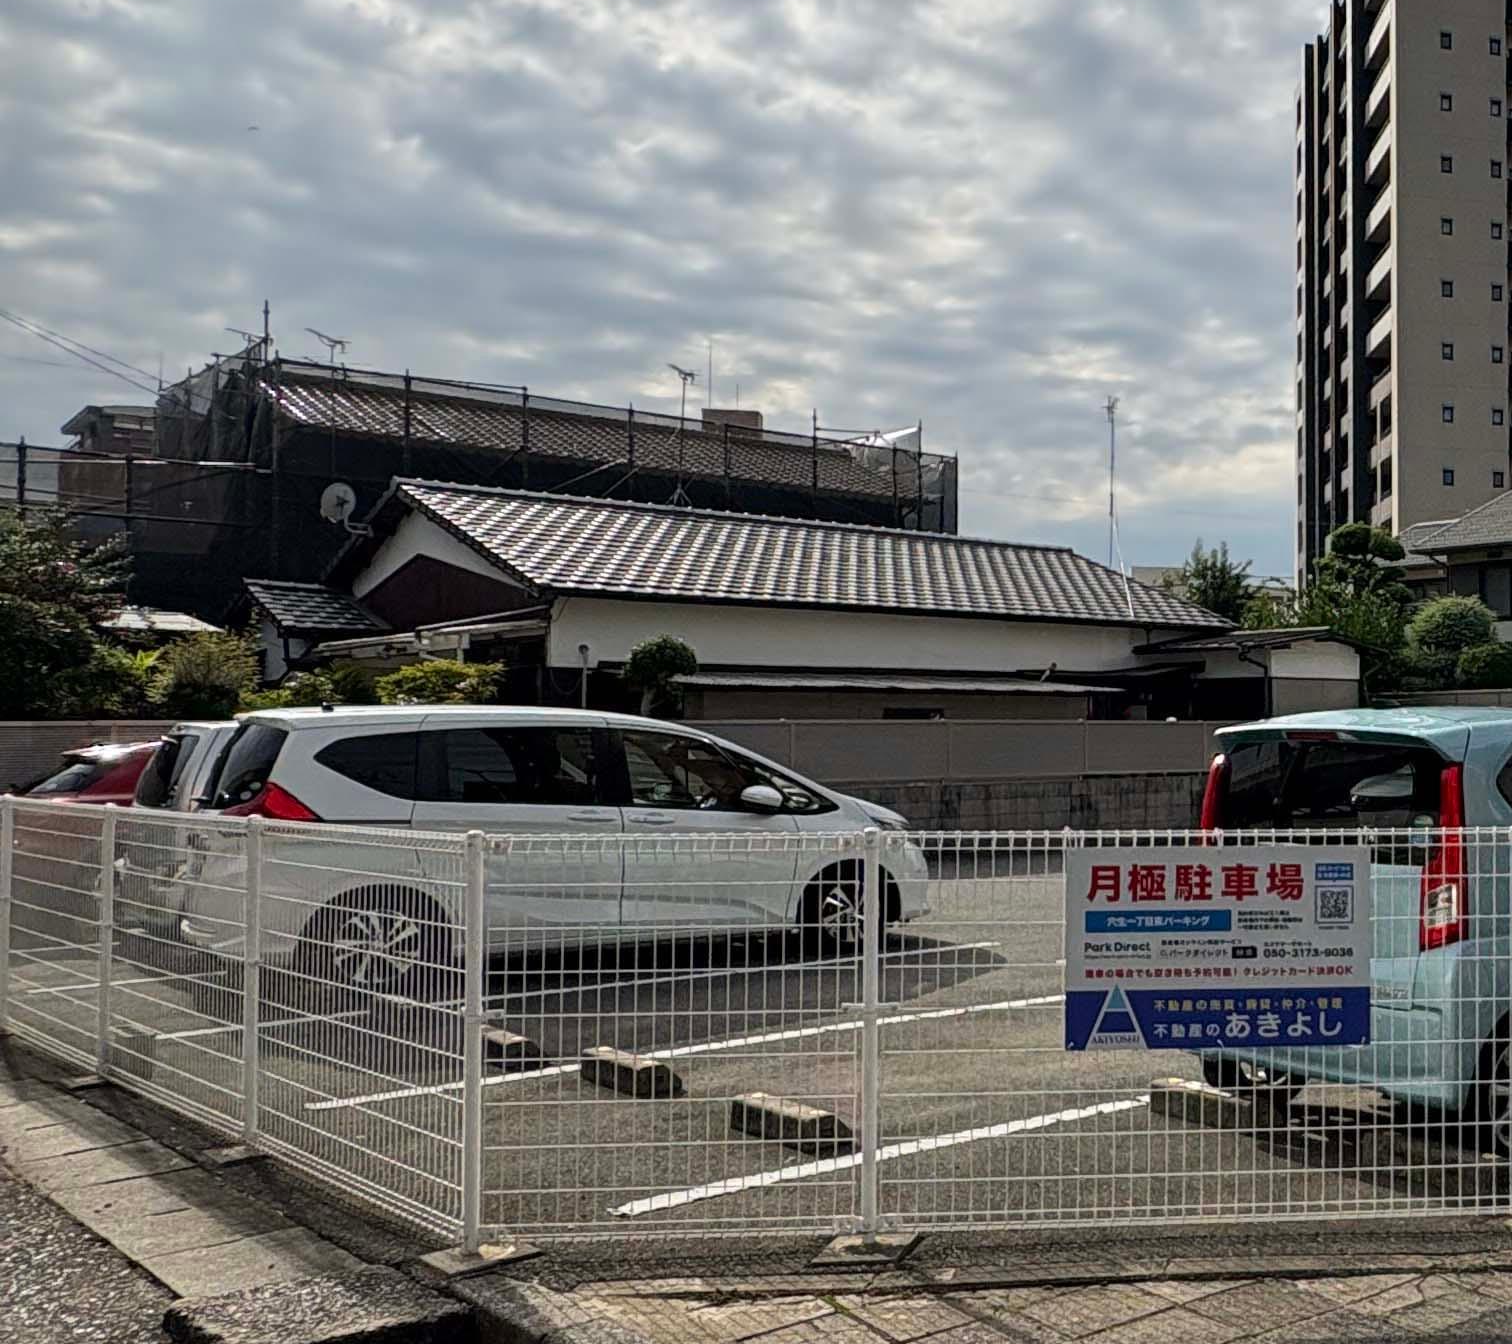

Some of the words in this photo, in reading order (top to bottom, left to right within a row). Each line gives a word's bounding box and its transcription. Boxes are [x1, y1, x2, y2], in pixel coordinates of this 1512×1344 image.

[1087, 863, 1304, 902] 月極駐車場
[1084, 942, 1112, 952] Park
[1114, 941, 1151, 952] Direct
[1263, 947, 1353, 958] 050-3173-9036
